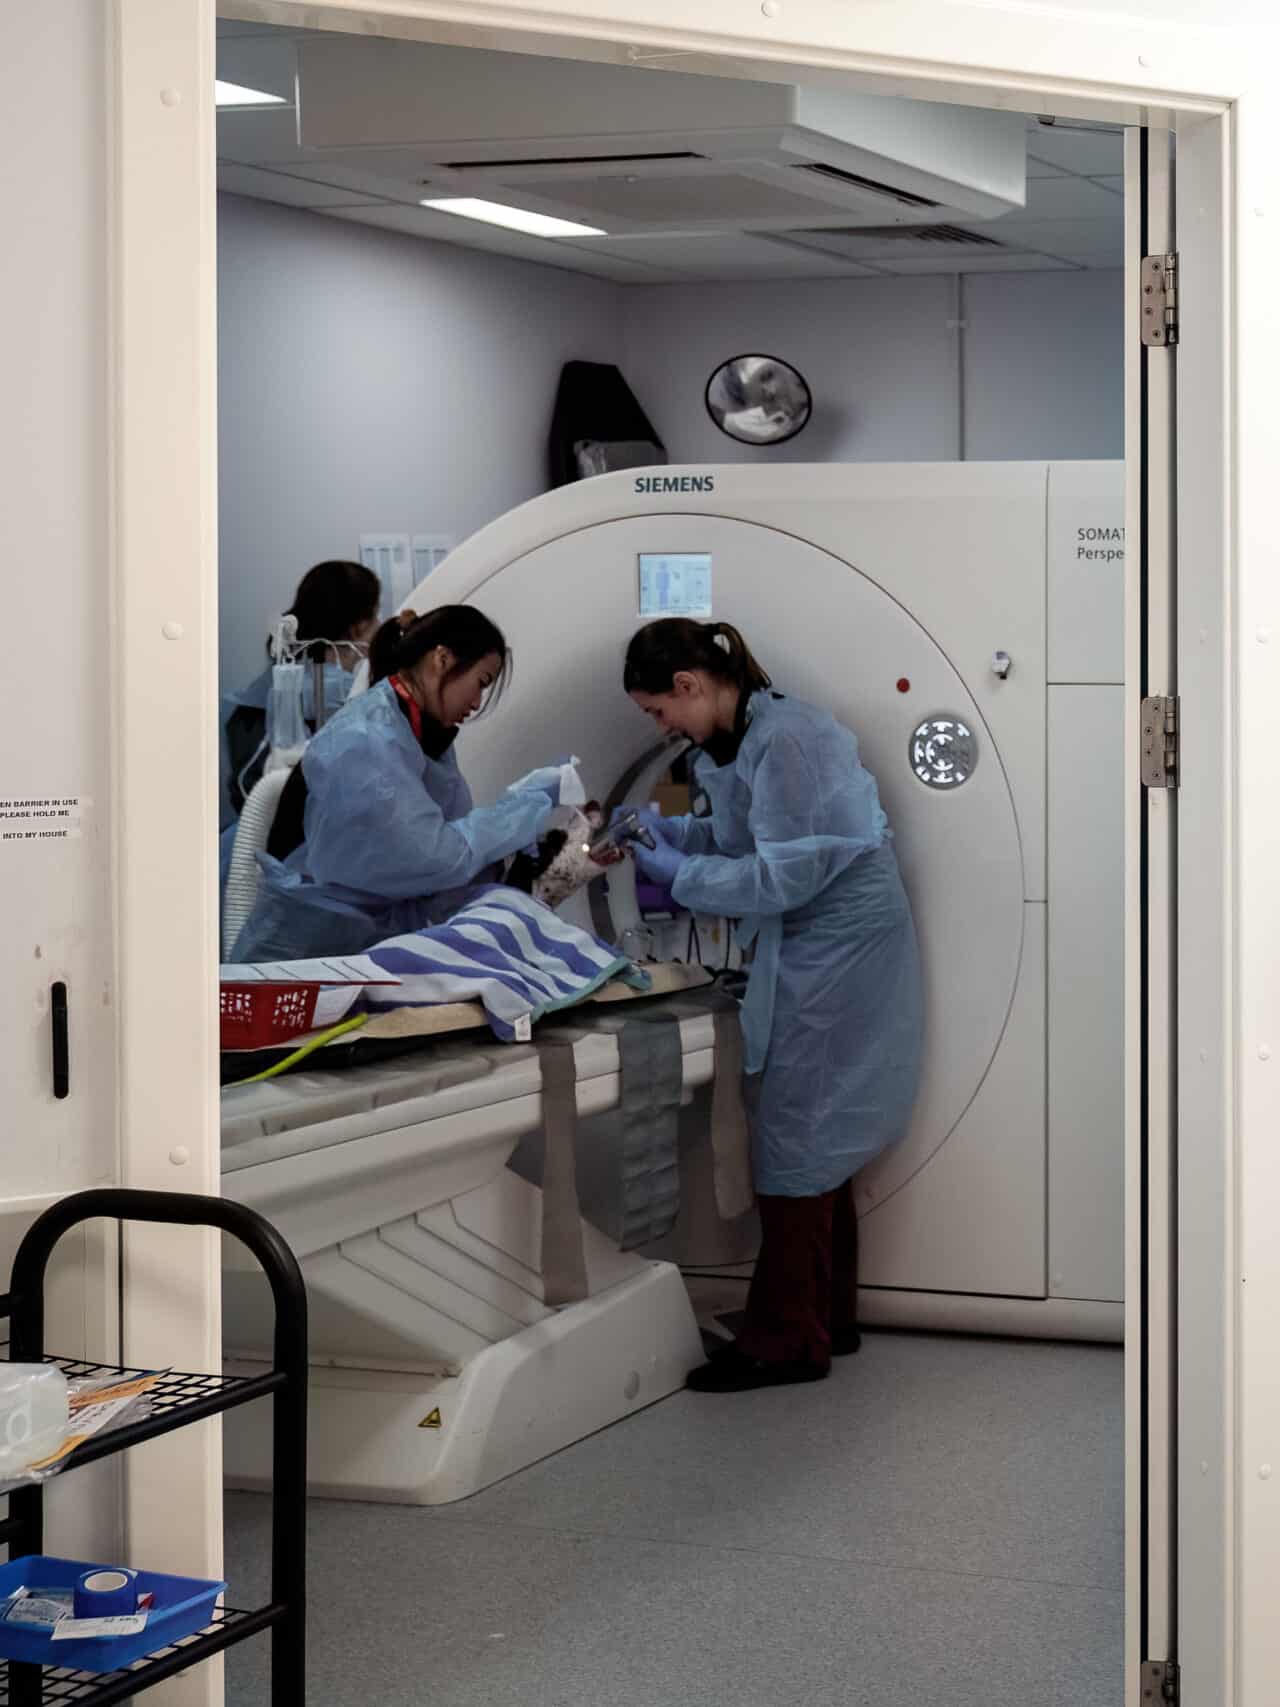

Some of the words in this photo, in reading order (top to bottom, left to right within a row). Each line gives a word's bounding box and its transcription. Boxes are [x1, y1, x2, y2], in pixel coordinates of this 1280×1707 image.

[634, 475, 715, 493] SIEMENS
[62, 798, 79, 806] USE
[58, 809, 70, 817] ME
